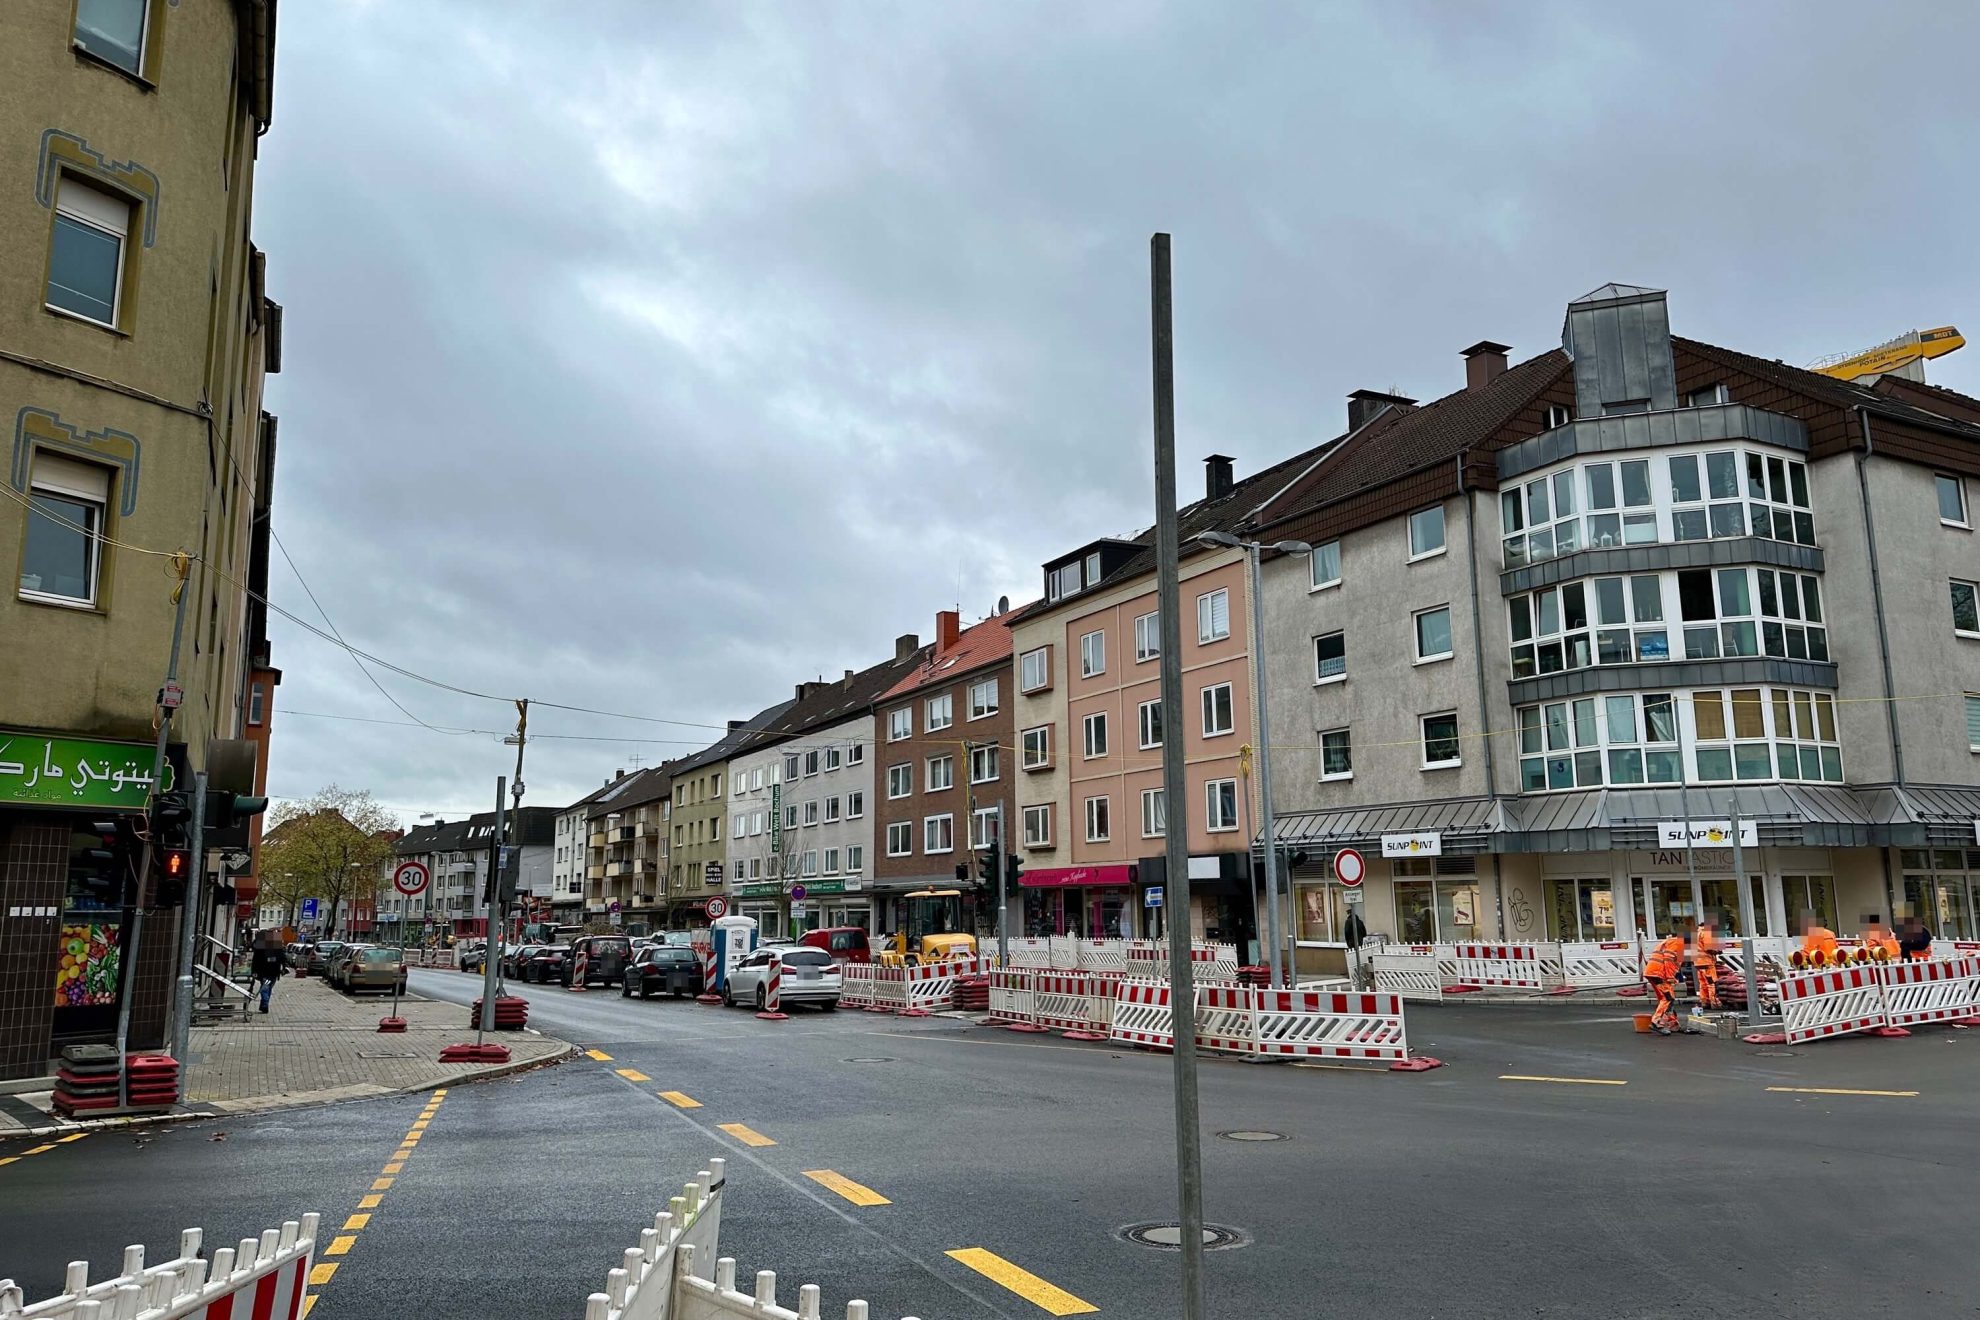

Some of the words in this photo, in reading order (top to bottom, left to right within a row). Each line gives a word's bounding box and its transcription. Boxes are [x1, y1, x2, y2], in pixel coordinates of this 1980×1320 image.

[70, 757, 154, 796] يتوتي
[401, 871, 422, 886] 30
[710, 903, 723, 914] 30
